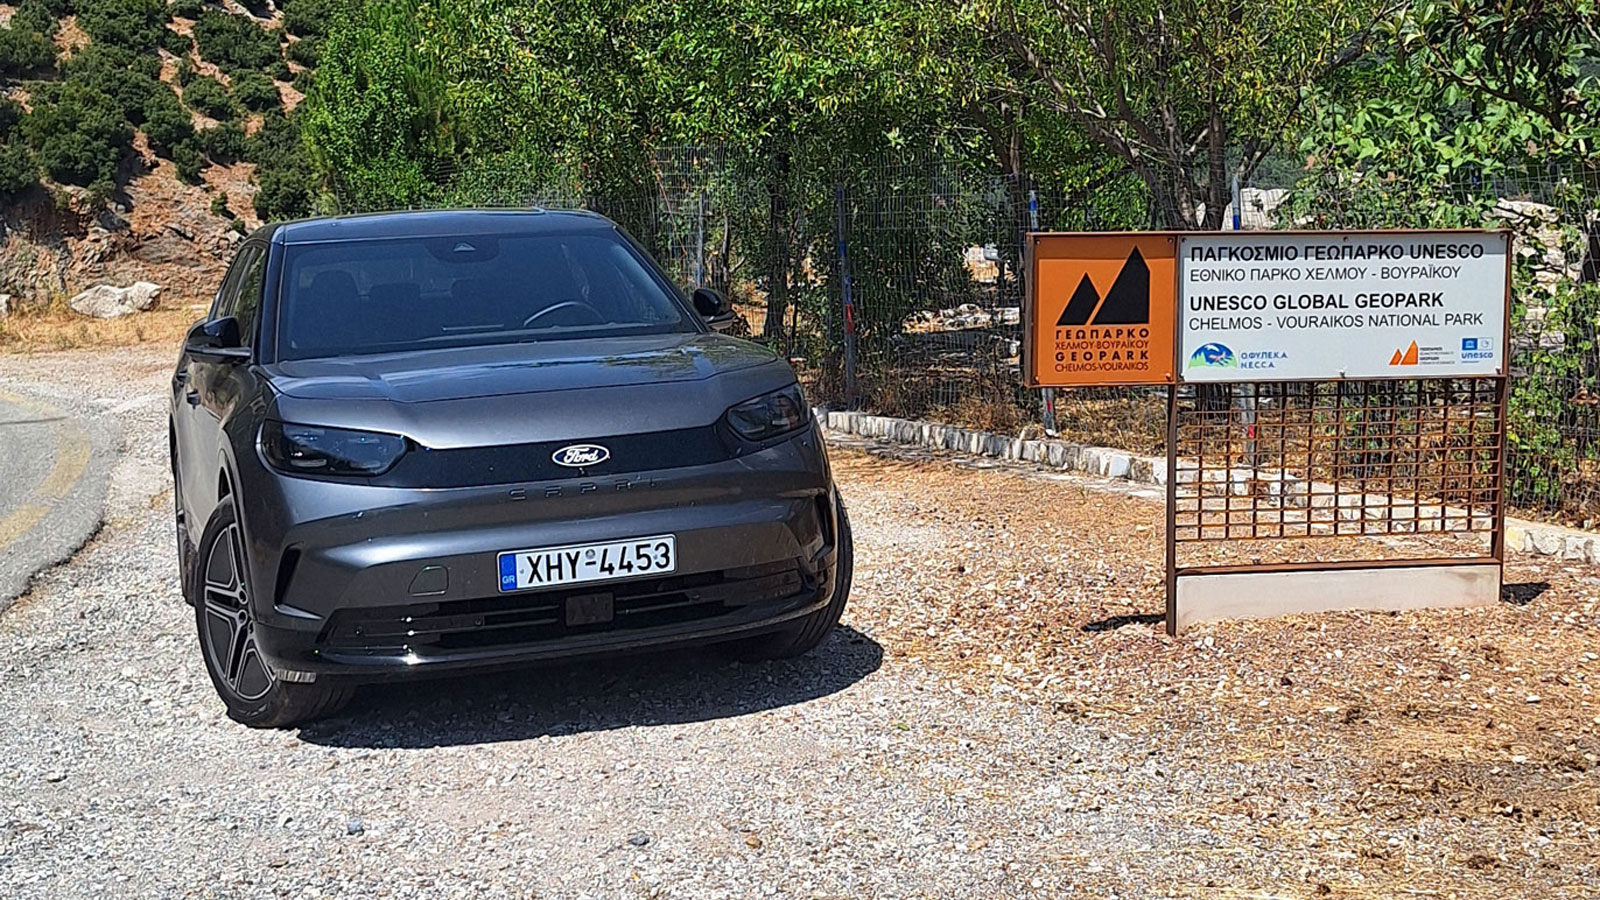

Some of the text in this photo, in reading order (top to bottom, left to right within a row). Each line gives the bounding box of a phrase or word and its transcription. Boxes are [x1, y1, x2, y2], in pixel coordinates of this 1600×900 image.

[1190, 244, 1484, 262] ΠΑΓΚΟΣΜΙΟ ΓΕΩΠΑΡΚΟ UNESCO
[1190, 269, 1246, 282] ΕΘΝΙΚΟ
[1250, 268, 1301, 281] ΠΑΡΚΟ
[1305, 267, 1368, 280] ΧΕΛΜΟΥ
[1381, 265, 1461, 280] ΒΟΥΡΑΪΚΟΥ
[1190, 293, 1444, 310] UNESCO GLOBAL GEOPARK
[1189, 317, 1263, 330] CHELMOS
[1277, 315, 1364, 329] VOURAIKOS
[1368, 314, 1440, 327] NATIONAL
[1445, 313, 1483, 326] PARK
[1056, 328, 1149, 340] ΓΕΩΠΑΡΚΟ
[1055, 351, 1148, 361] GEOPARK
[563, 448, 598, 463] Ford
[502, 576, 515, 584] GR
